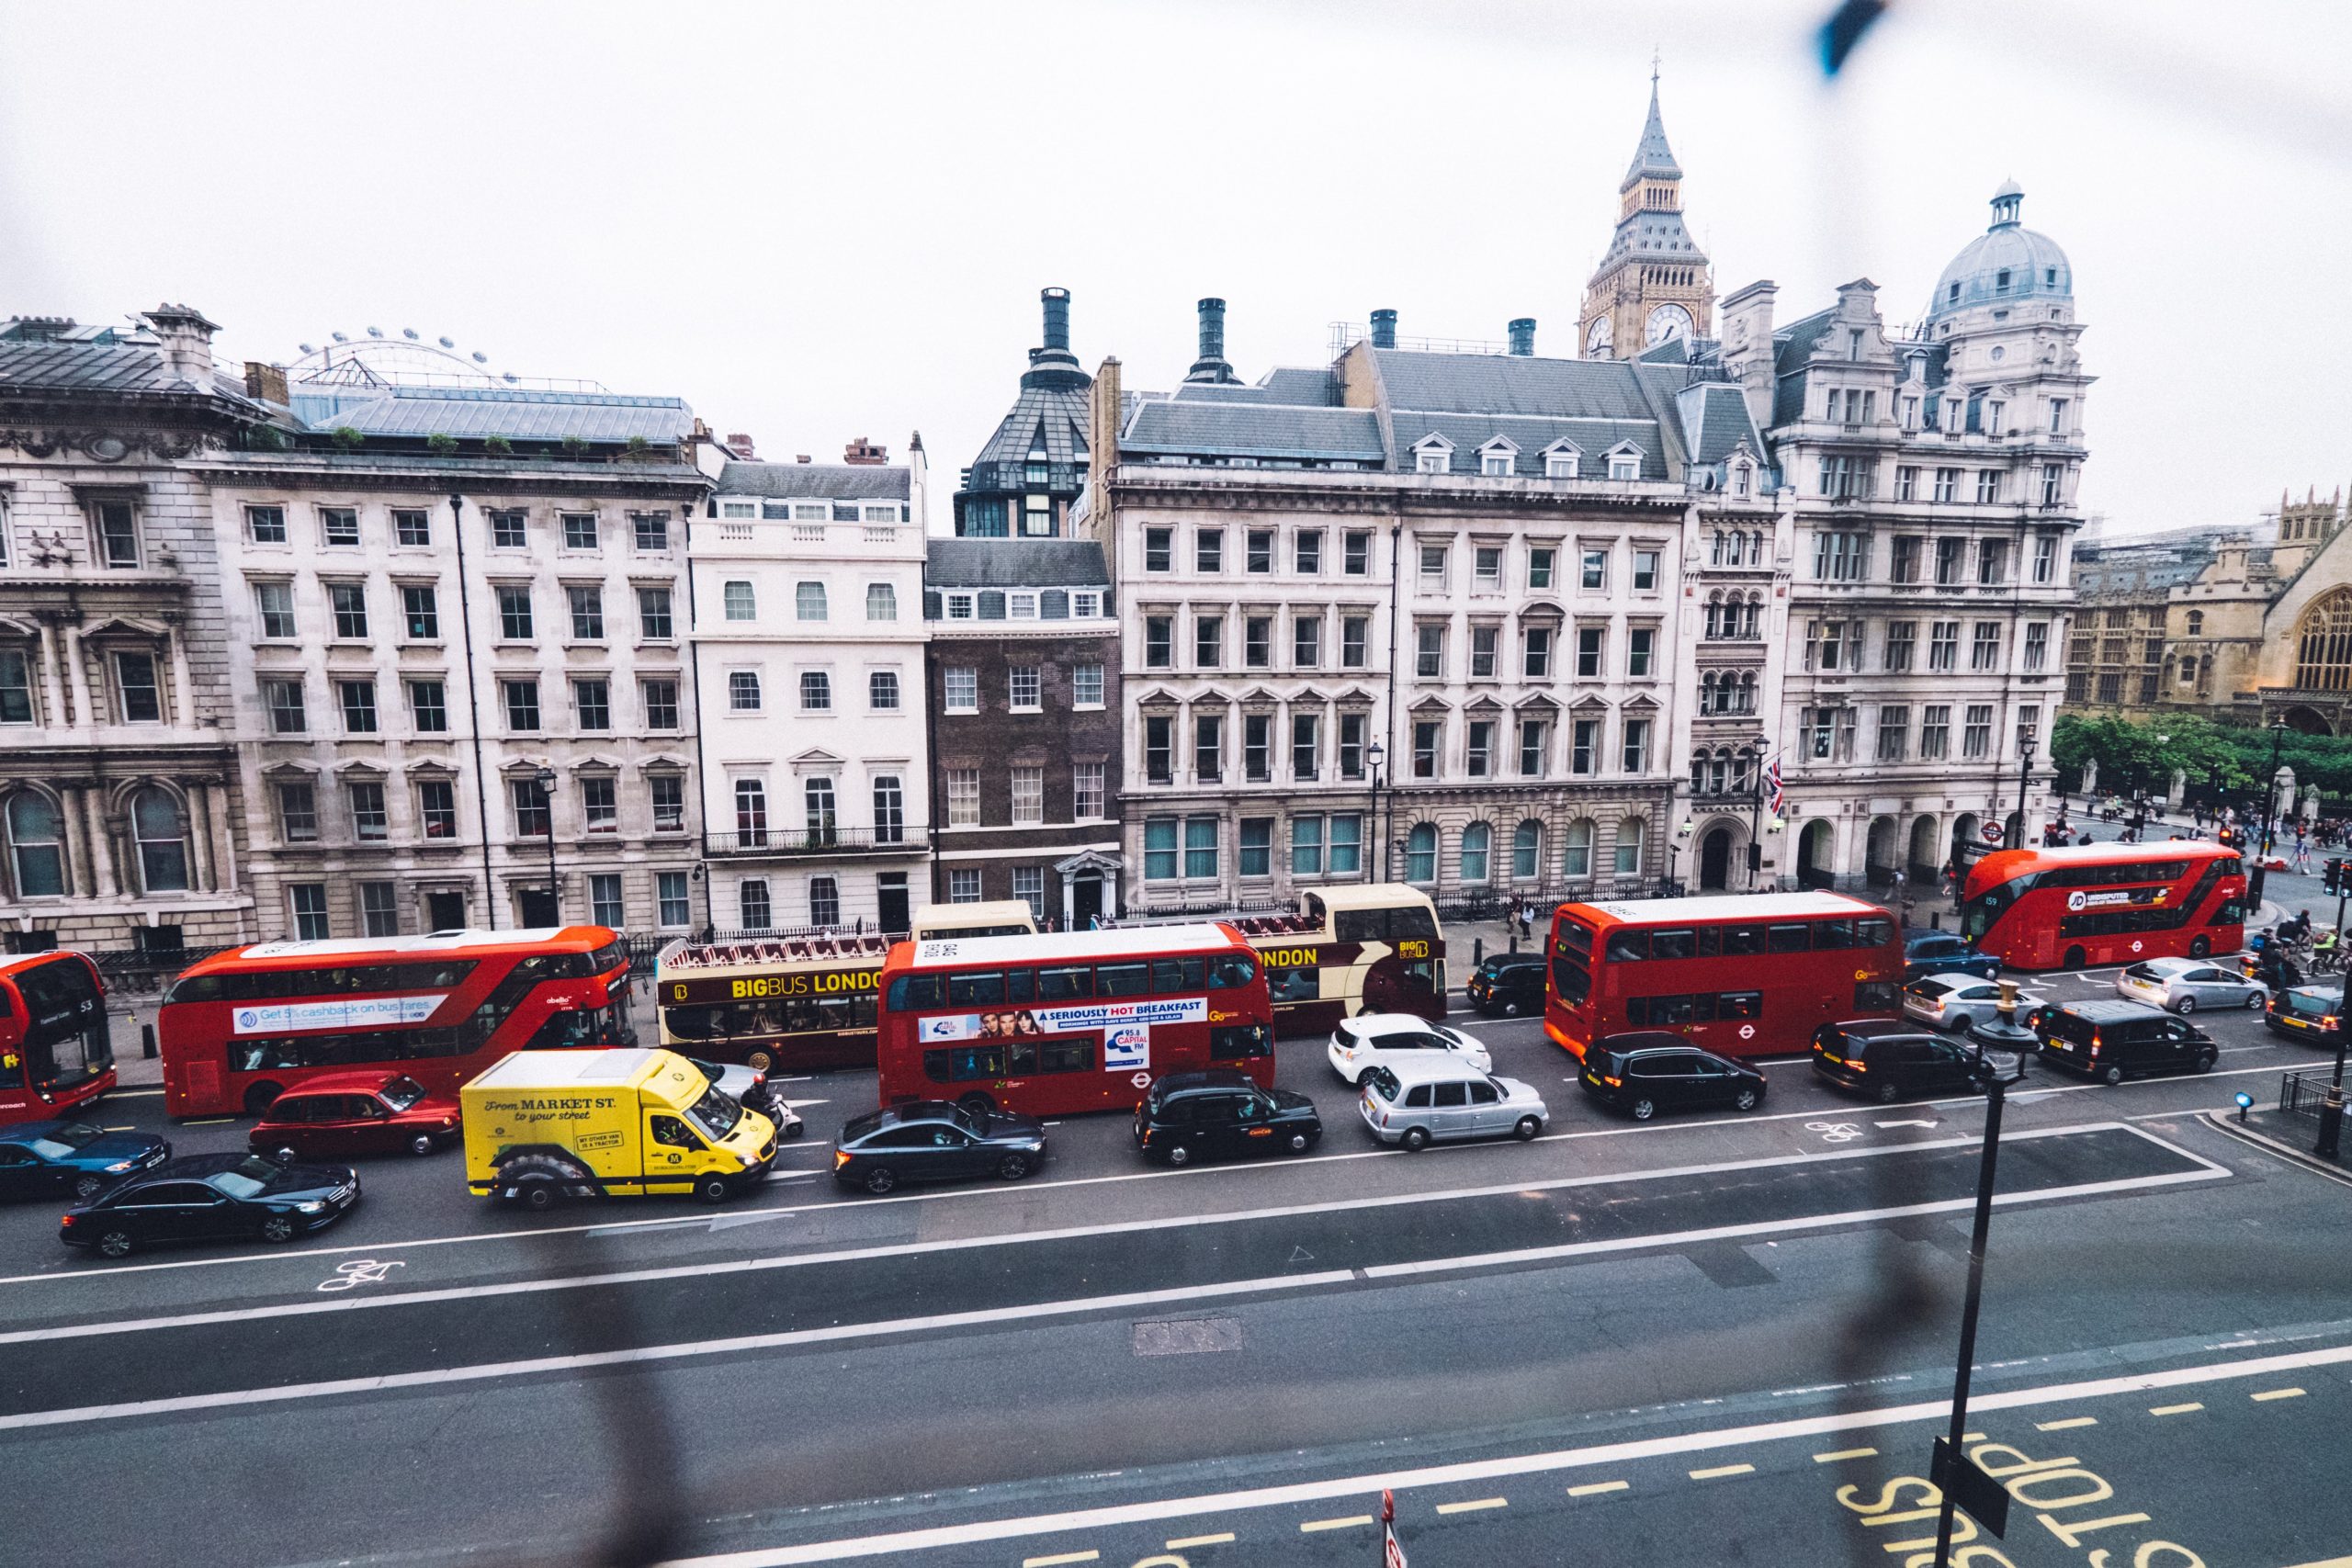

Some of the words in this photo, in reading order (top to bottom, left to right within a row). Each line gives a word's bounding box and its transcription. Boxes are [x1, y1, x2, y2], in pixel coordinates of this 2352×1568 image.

[1985, 897, 1997, 906] 159
[2072, 896, 2084, 906] JD
[1399, 941, 1415, 951] BIG
[1399, 950, 1415, 960] BUS
[81, 999, 93, 1012] 53
[260, 1009, 281, 1020] Get
[300, 1003, 358, 1018] cashback
[361, 1004, 376, 1013] on
[378, 1001, 399, 1012] bus
[1039, 1012, 1047, 1021] A
[1050, 1008, 1109, 1021] SERIOUSLY
[1111, 1007, 1135, 1016] HOT
[1136, 1001, 1202, 1014] BREAKFAST
[1125, 1029, 1140, 1037] 95.8
[1117, 1036, 1148, 1044] CAPITAL
[484, 1100, 520, 1111] From
[521, 1098, 593, 1111] MARKET
[595, 1098, 616, 1109] ST.
[514, 1111, 527, 1121] to
[529, 1111, 556, 1123] your
[559, 1111, 591, 1121] street
[670, 1155, 680, 1163] M
